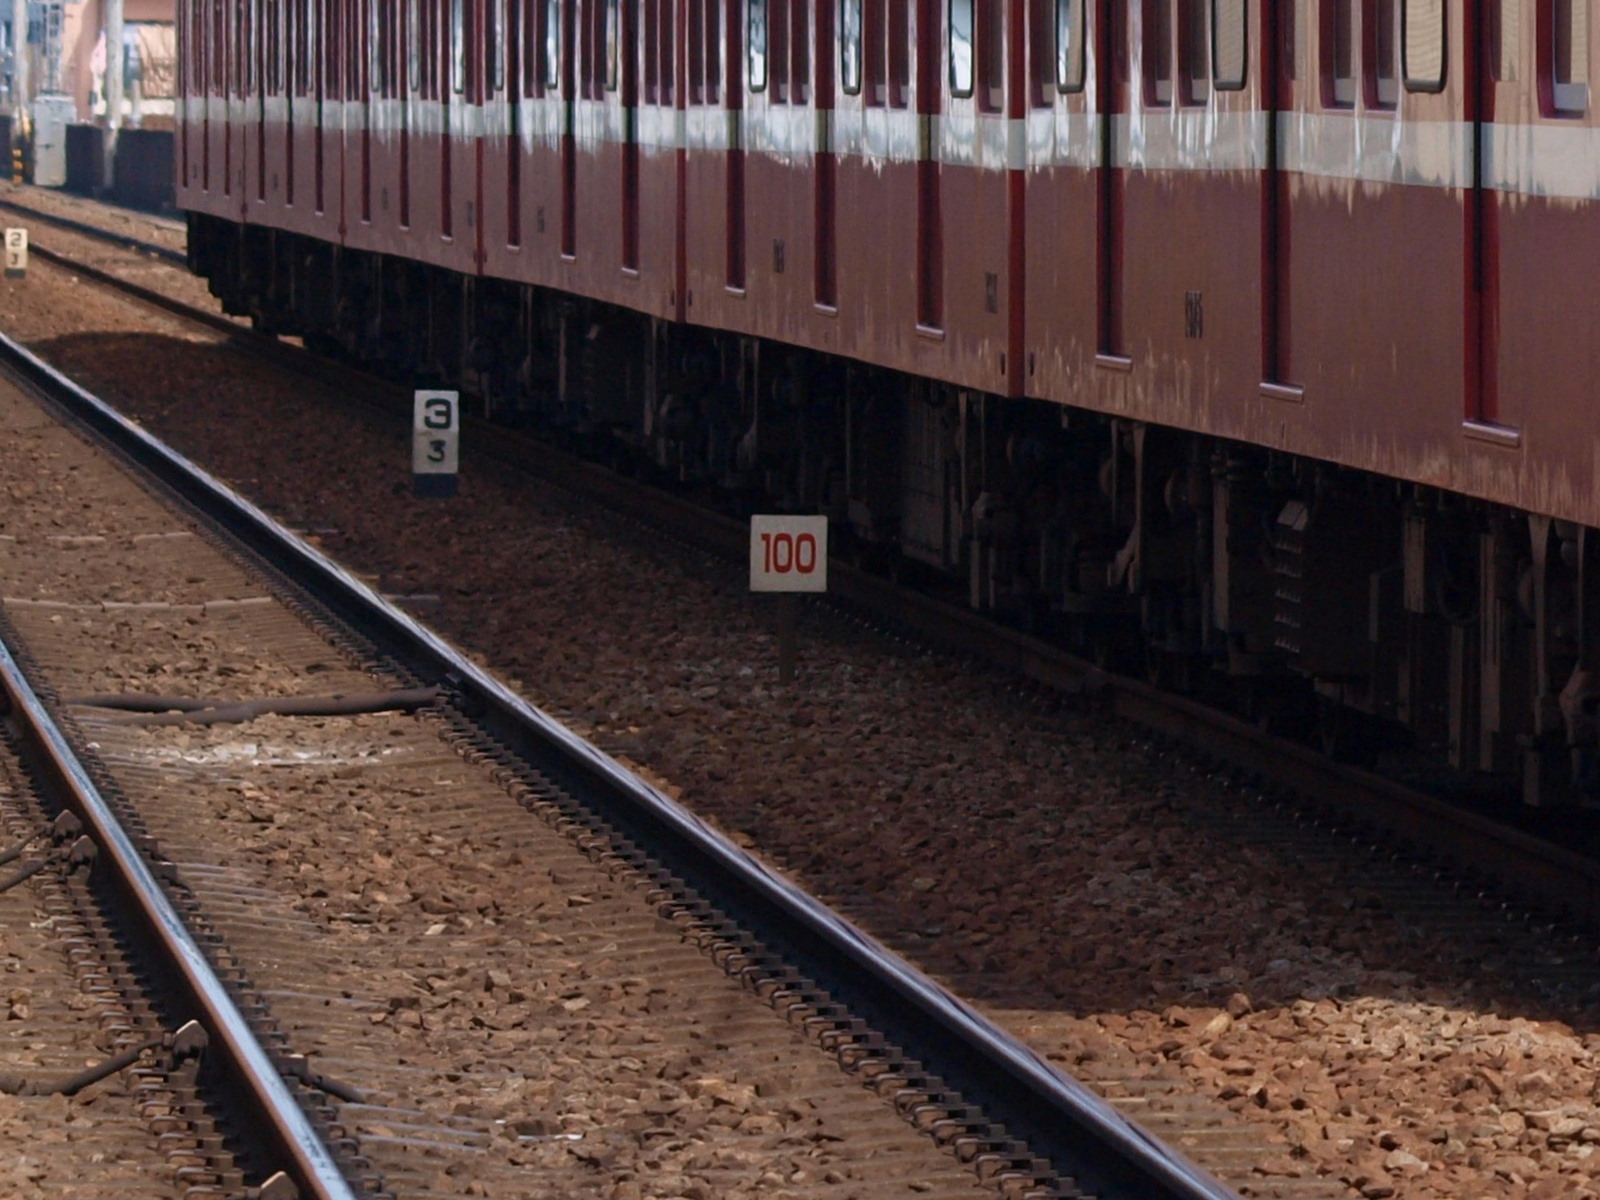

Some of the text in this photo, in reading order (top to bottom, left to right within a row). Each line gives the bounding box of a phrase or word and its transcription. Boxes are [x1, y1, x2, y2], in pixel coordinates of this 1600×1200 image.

[424, 398, 452, 429] 3
[427, 439, 446, 462] 3
[761, 532, 817, 574] 100
